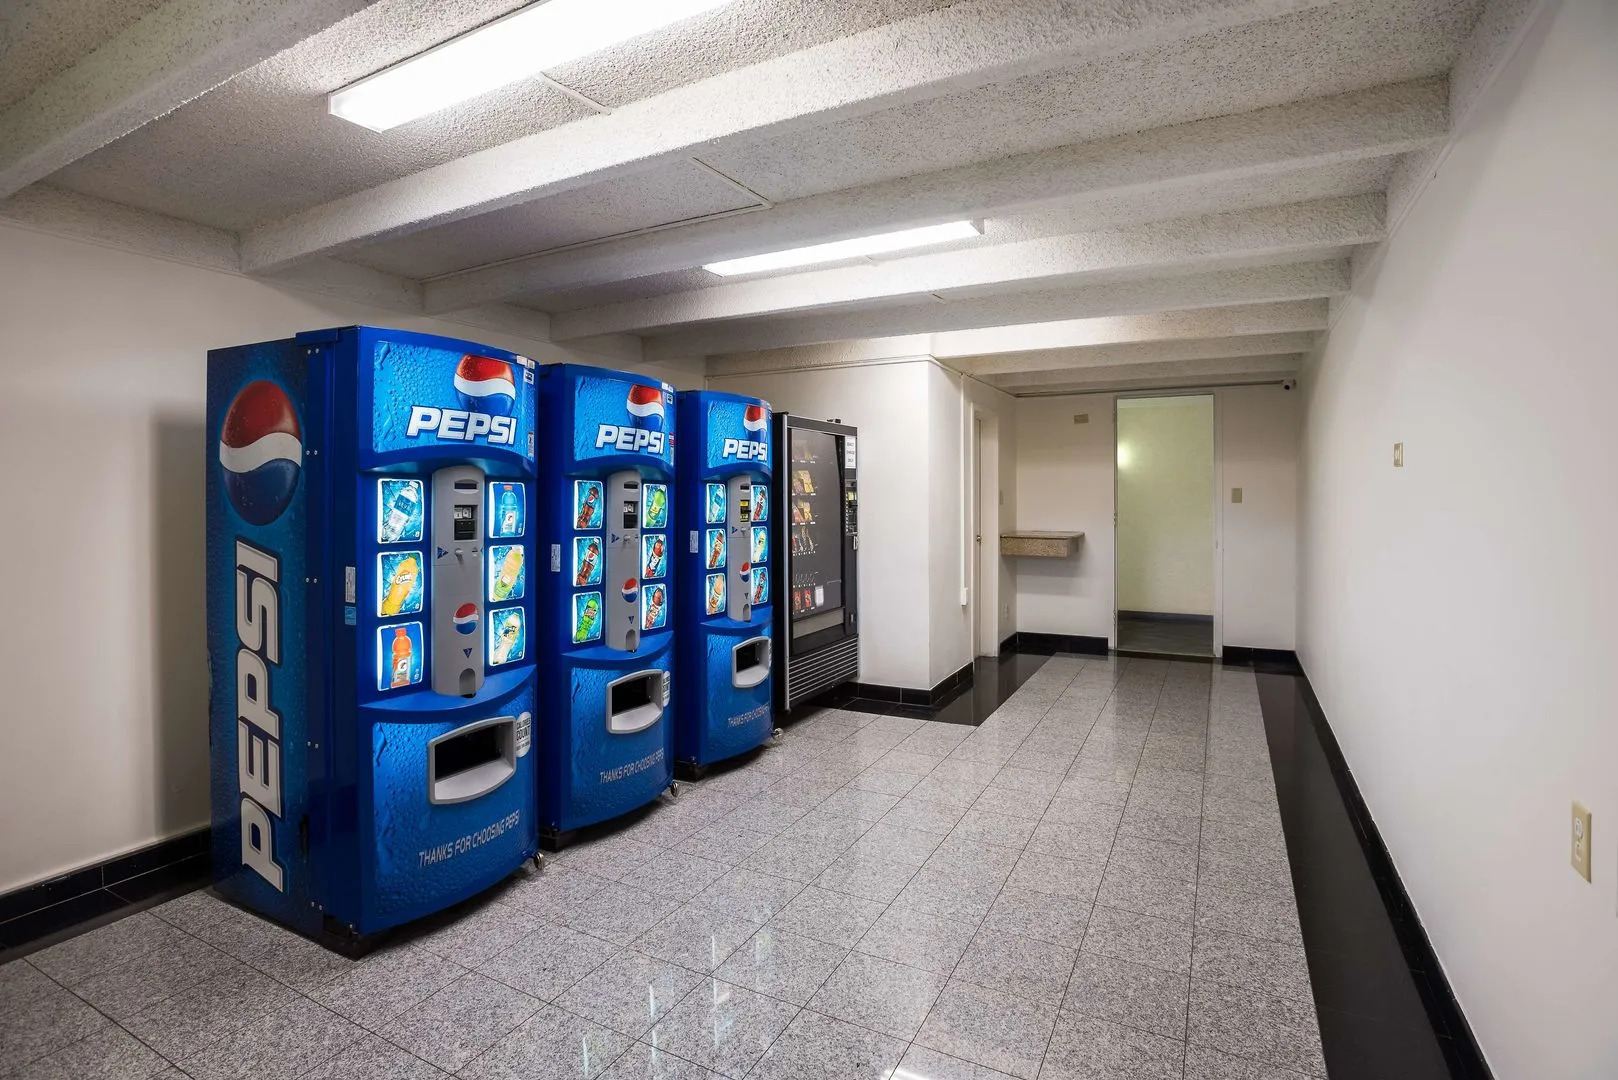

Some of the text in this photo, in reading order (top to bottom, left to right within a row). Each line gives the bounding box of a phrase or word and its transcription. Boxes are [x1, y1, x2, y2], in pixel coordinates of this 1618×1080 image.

[406, 405, 518, 446] PEPSI
[595, 424, 665, 454] PEPSI
[722, 438, 768, 462] PEPSI
[236, 540, 284, 893] PEPSI
[600, 766, 623, 785] THANKS
[623, 762, 635, 777] FOR
[418, 842, 453, 867] THANKS
[454, 835, 472, 856] FOR
[472, 818, 505, 848] CHOOSING
